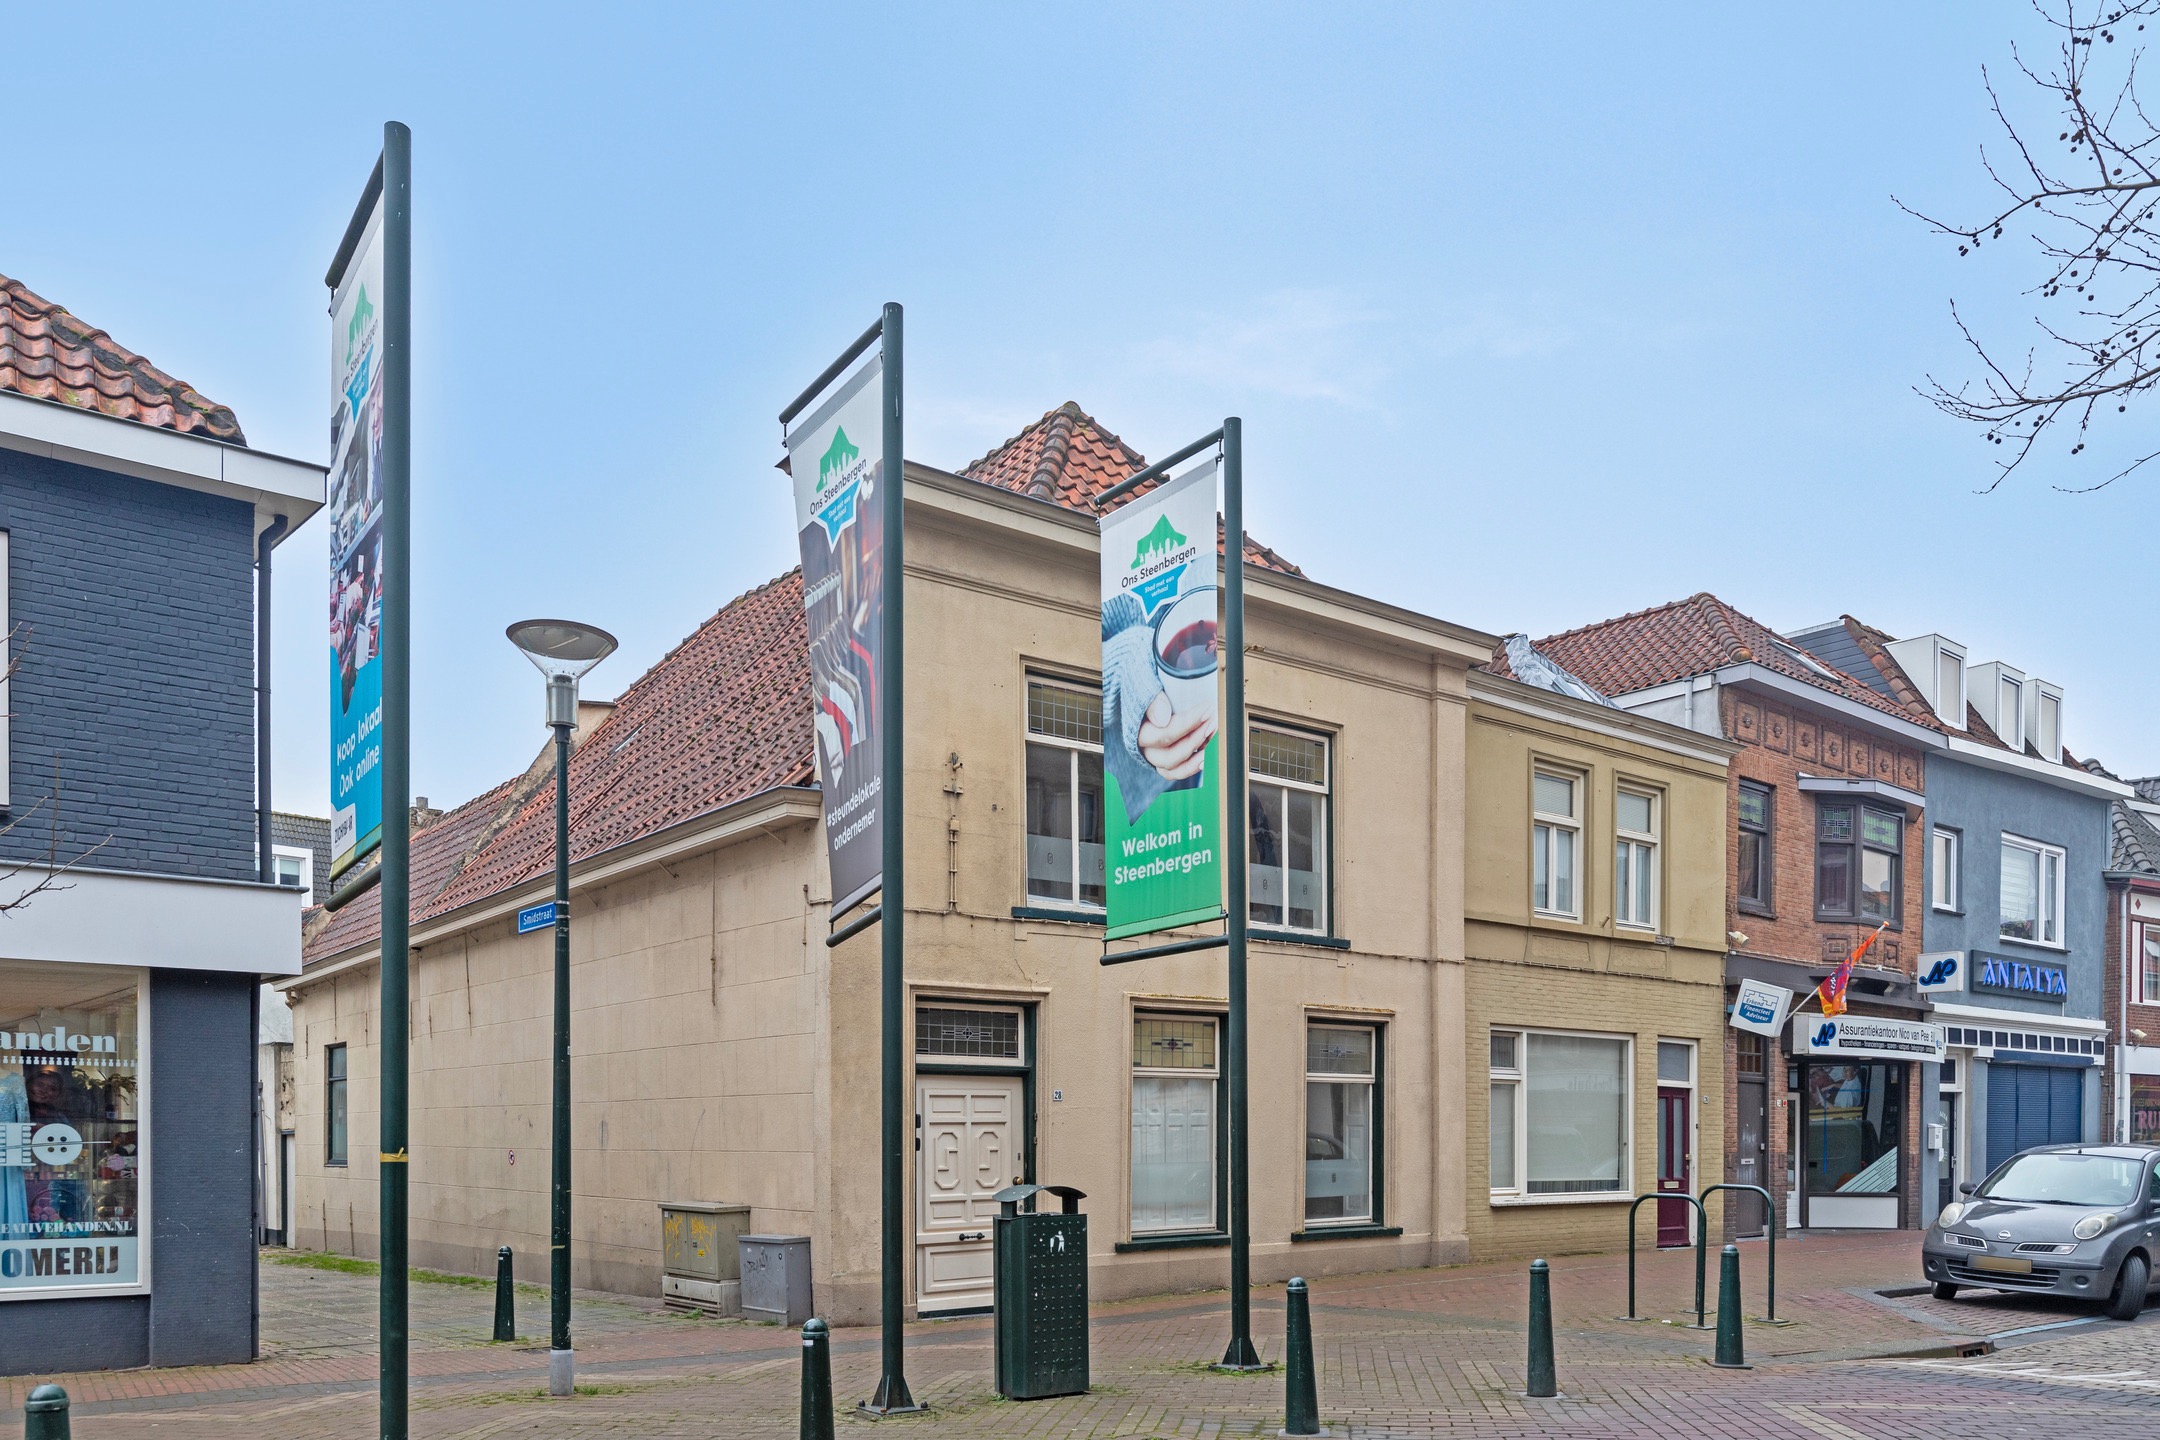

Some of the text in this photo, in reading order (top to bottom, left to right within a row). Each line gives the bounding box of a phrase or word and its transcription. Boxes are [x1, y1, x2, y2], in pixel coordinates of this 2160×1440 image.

[810, 459, 867, 515] Ons Steenbergen
[1121, 546, 1196, 588] Ons Steenbergen
[337, 696, 383, 767] Koop lokaal
[339, 744, 380, 798] Ook online
[827, 774, 881, 828] #steundelokale
[834, 808, 876, 851] ondernemer
[1122, 821, 1203, 857] Welkom in
[1114, 848, 1212, 885] Steenbergen
[1982, 957, 2067, 996] ANTALYA
[1743, 1004, 1772, 1016] Financieel
[1745, 1011, 1769, 1021] Adviseur
[0, 1026, 118, 1053] anden
[1839, 1022, 1898, 1039] Assurantiekantoor
[1899, 1027, 1910, 1040] Nico
[1911, 1031, 1920, 1041] van
[1054, 1090, 1062, 1100] 28
[1, 1245, 119, 1278] OMERIJ
